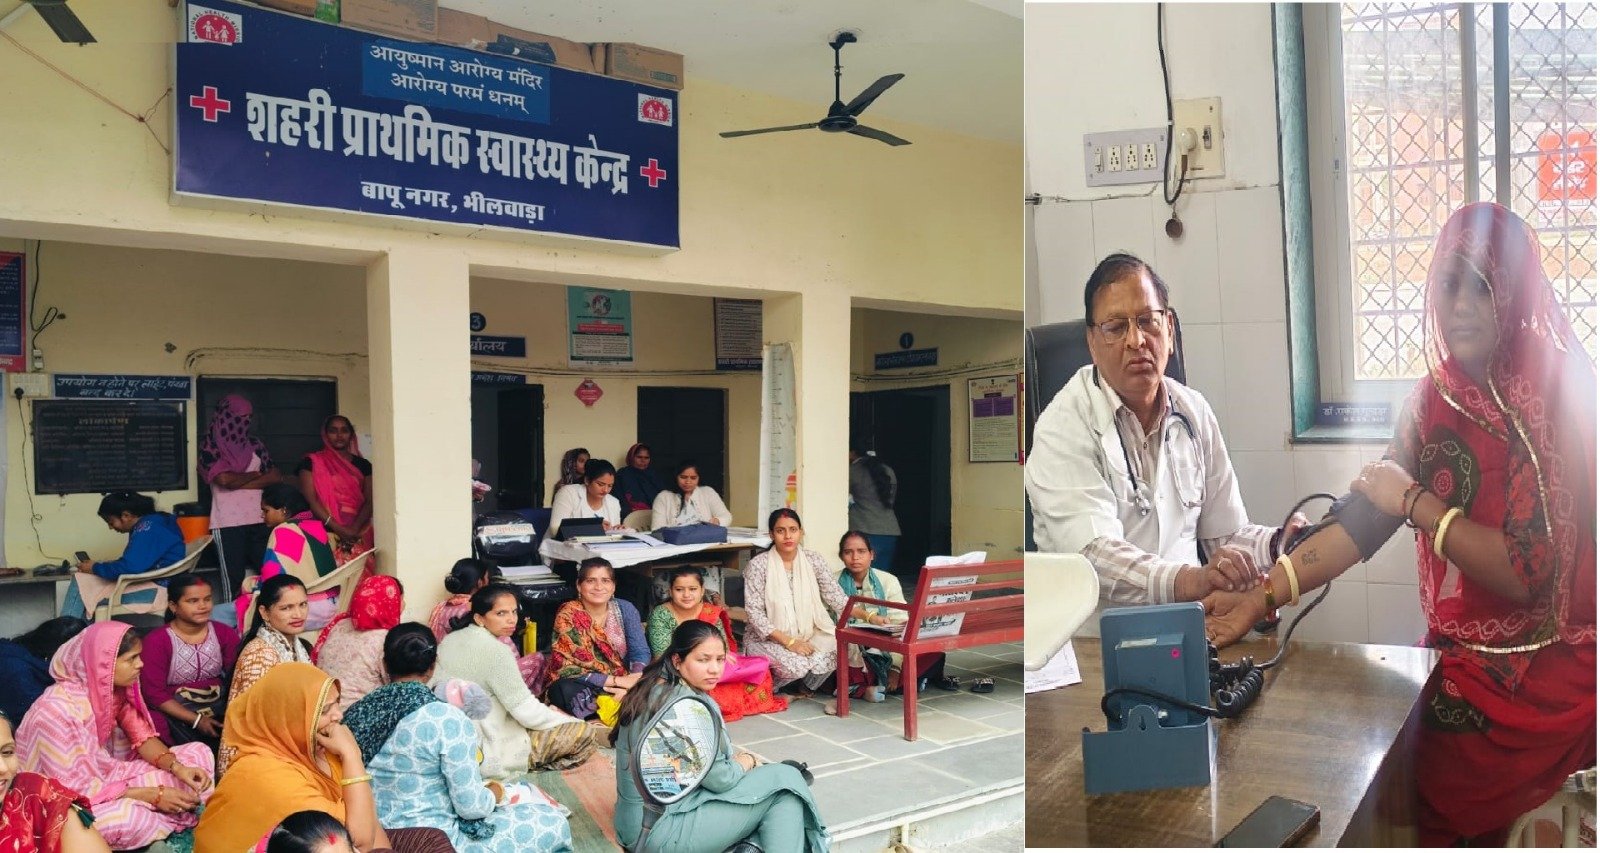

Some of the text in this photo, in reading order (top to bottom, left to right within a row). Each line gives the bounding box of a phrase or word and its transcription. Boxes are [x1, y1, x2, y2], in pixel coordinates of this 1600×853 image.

[369, 45, 543, 90] आयुष्मान आरोग्य मंदिर
[390, 71, 530, 114] आरोग्य परमं धनम्
[245, 88, 631, 195] शहरी प्राथमिक स्वास्थ्य केन्द्र
[360, 181, 545, 224] बापू नगर, भीलवाड़ा
[470, 337, 507, 351] र्यालय
